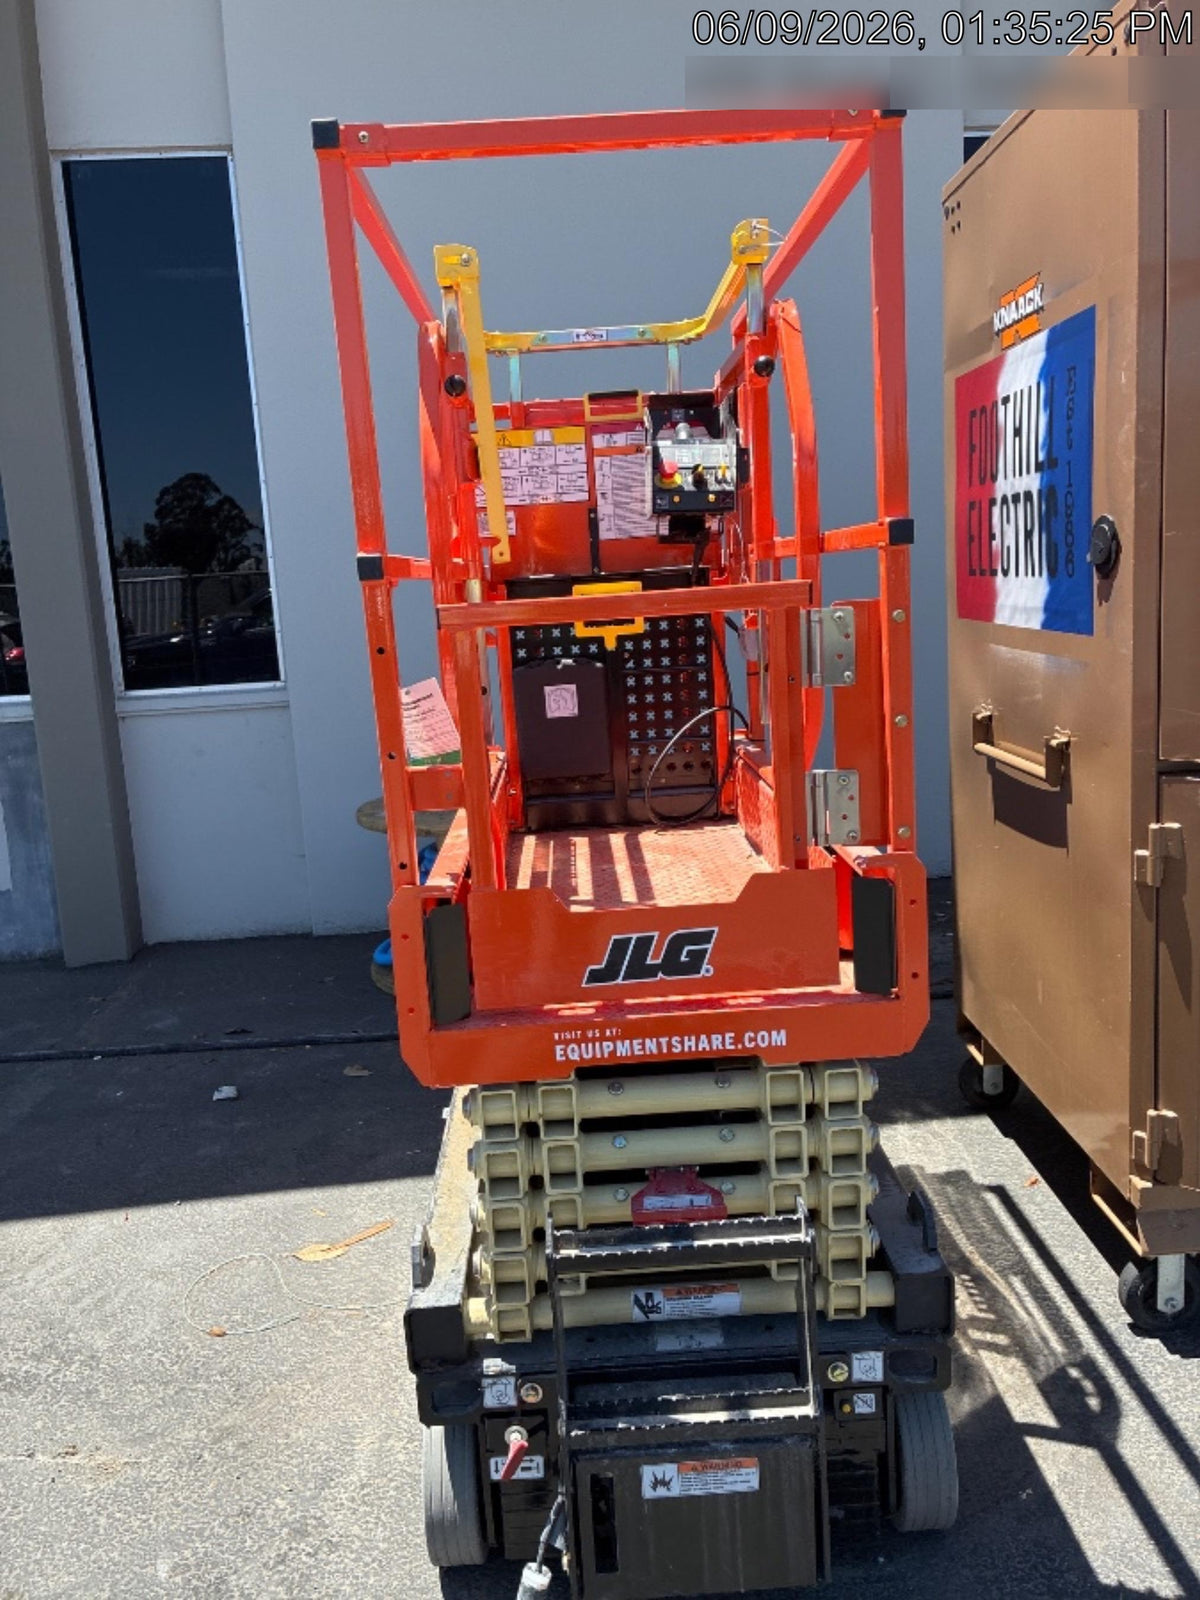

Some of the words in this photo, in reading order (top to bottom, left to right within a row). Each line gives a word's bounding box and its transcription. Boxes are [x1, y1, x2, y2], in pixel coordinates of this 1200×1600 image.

[993, 283, 1044, 333] KNAACK
[968, 376, 1059, 488] FOOTHILL
[968, 486, 1059, 578] ELECTRIC
[582, 927, 719, 987] JLG
[553, 1030, 582, 1040] VISIT
[586, 1028, 600, 1038] US
[555, 1029, 788, 1062] EQUIPMENTSHARE.COM
